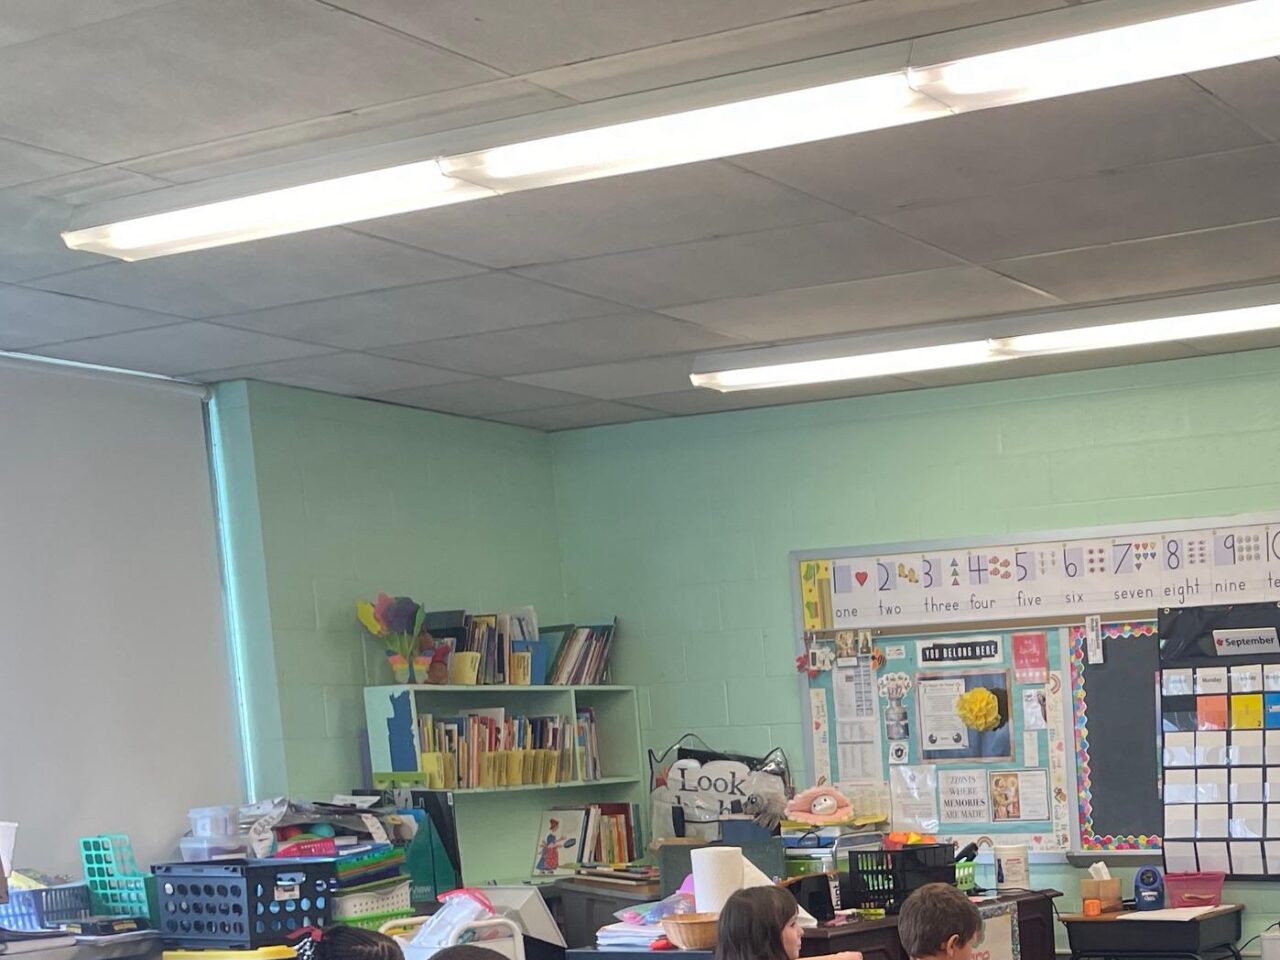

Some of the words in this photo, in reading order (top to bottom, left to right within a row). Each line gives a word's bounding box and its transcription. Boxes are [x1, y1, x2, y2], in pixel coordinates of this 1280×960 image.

[1167, 539, 1180, 570] 8
[1223, 534, 1236, 565] 9
[1015, 552, 1028, 582] 5
[1063, 546, 1078, 578] 6
[1112, 543, 1133, 575] 7
[877, 562, 891, 592] 2
[923, 560, 933, 588] 3
[968, 555, 988, 585] 4
[1113, 587, 1154, 601] seven
[1163, 577, 1201, 605] eight
[1215, 580, 1247, 594] nine
[924, 596, 960, 614] three
[969, 593, 997, 610] four
[1017, 591, 1042, 607] five
[1065, 591, 1084, 604] six
[835, 607, 859, 619] one
[878, 600, 902, 616] two
[1225, 635, 1276, 649] September
[925, 647, 940, 660] YOU
[943, 646, 972, 658] BELONG
[975, 644, 995, 656] HERE
[1202, 676, 1222, 684] Monday
[677, 767, 747, 797] Look
[944, 799, 986, 808] MEMORIES
